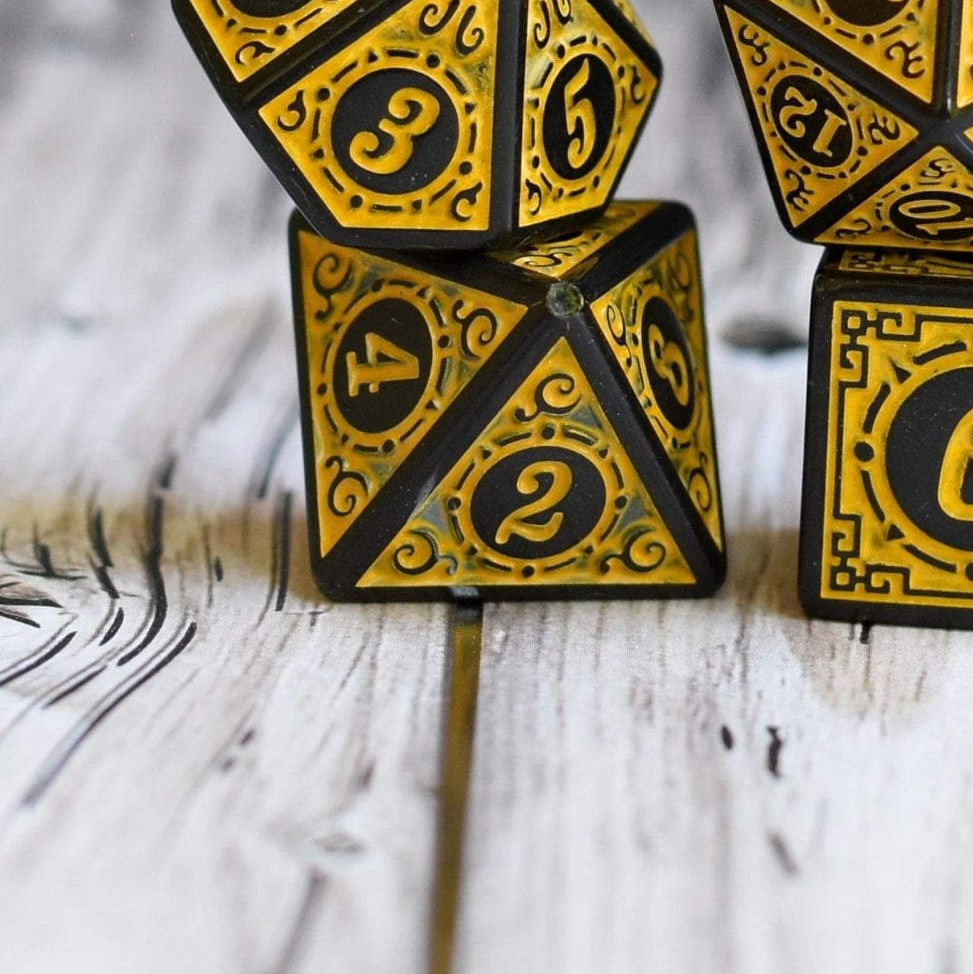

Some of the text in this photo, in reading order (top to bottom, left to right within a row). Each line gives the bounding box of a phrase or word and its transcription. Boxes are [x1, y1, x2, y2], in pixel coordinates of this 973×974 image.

[348, 86, 442, 175] 3
[562, 57, 597, 171] 5
[777, 88, 848, 157] 12
[345, 332, 421, 398] 4
[494, 460, 575, 545] 2
